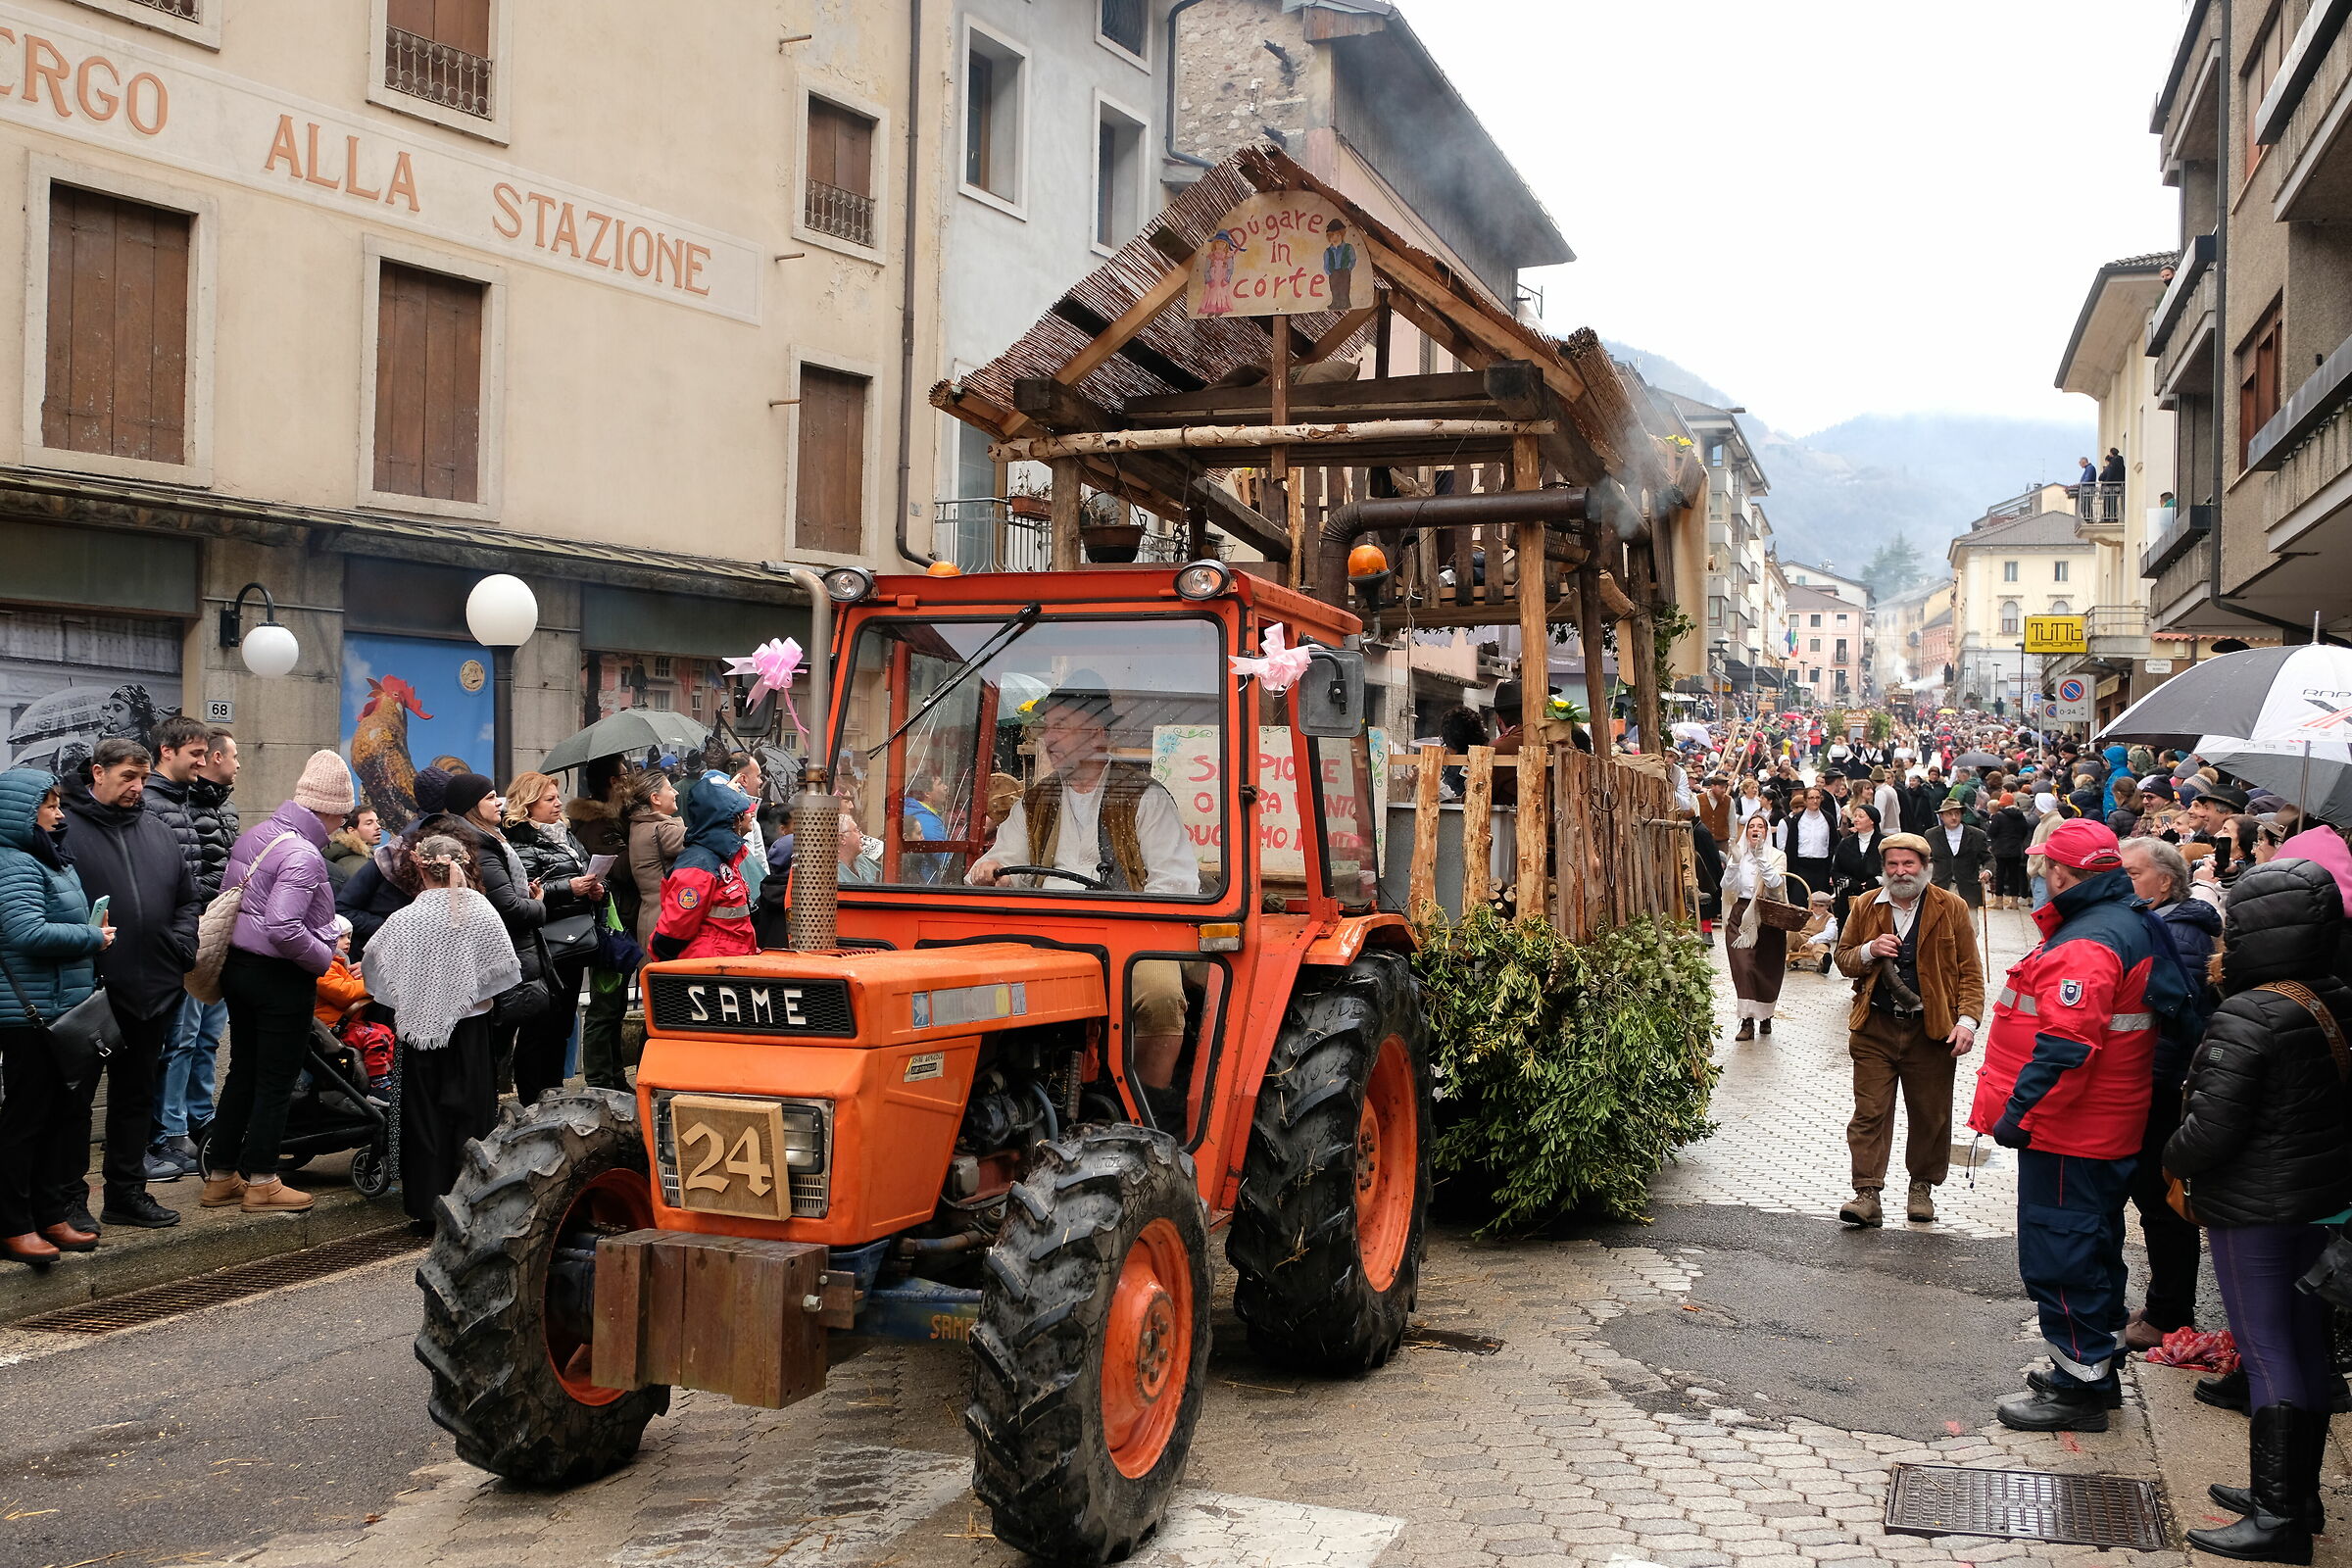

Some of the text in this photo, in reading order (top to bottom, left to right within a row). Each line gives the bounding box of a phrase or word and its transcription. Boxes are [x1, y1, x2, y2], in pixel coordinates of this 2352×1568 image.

[264, 114, 420, 213] ALLA
[492, 182, 711, 296] STAZIONE
[1270, 241, 1293, 268] in
[212, 703, 227, 715] 68
[1188, 753, 1341, 784] S PIOE
[1193, 791, 1214, 814] O
[688, 985, 807, 1025] SAME
[680, 1121, 773, 1198] 24
